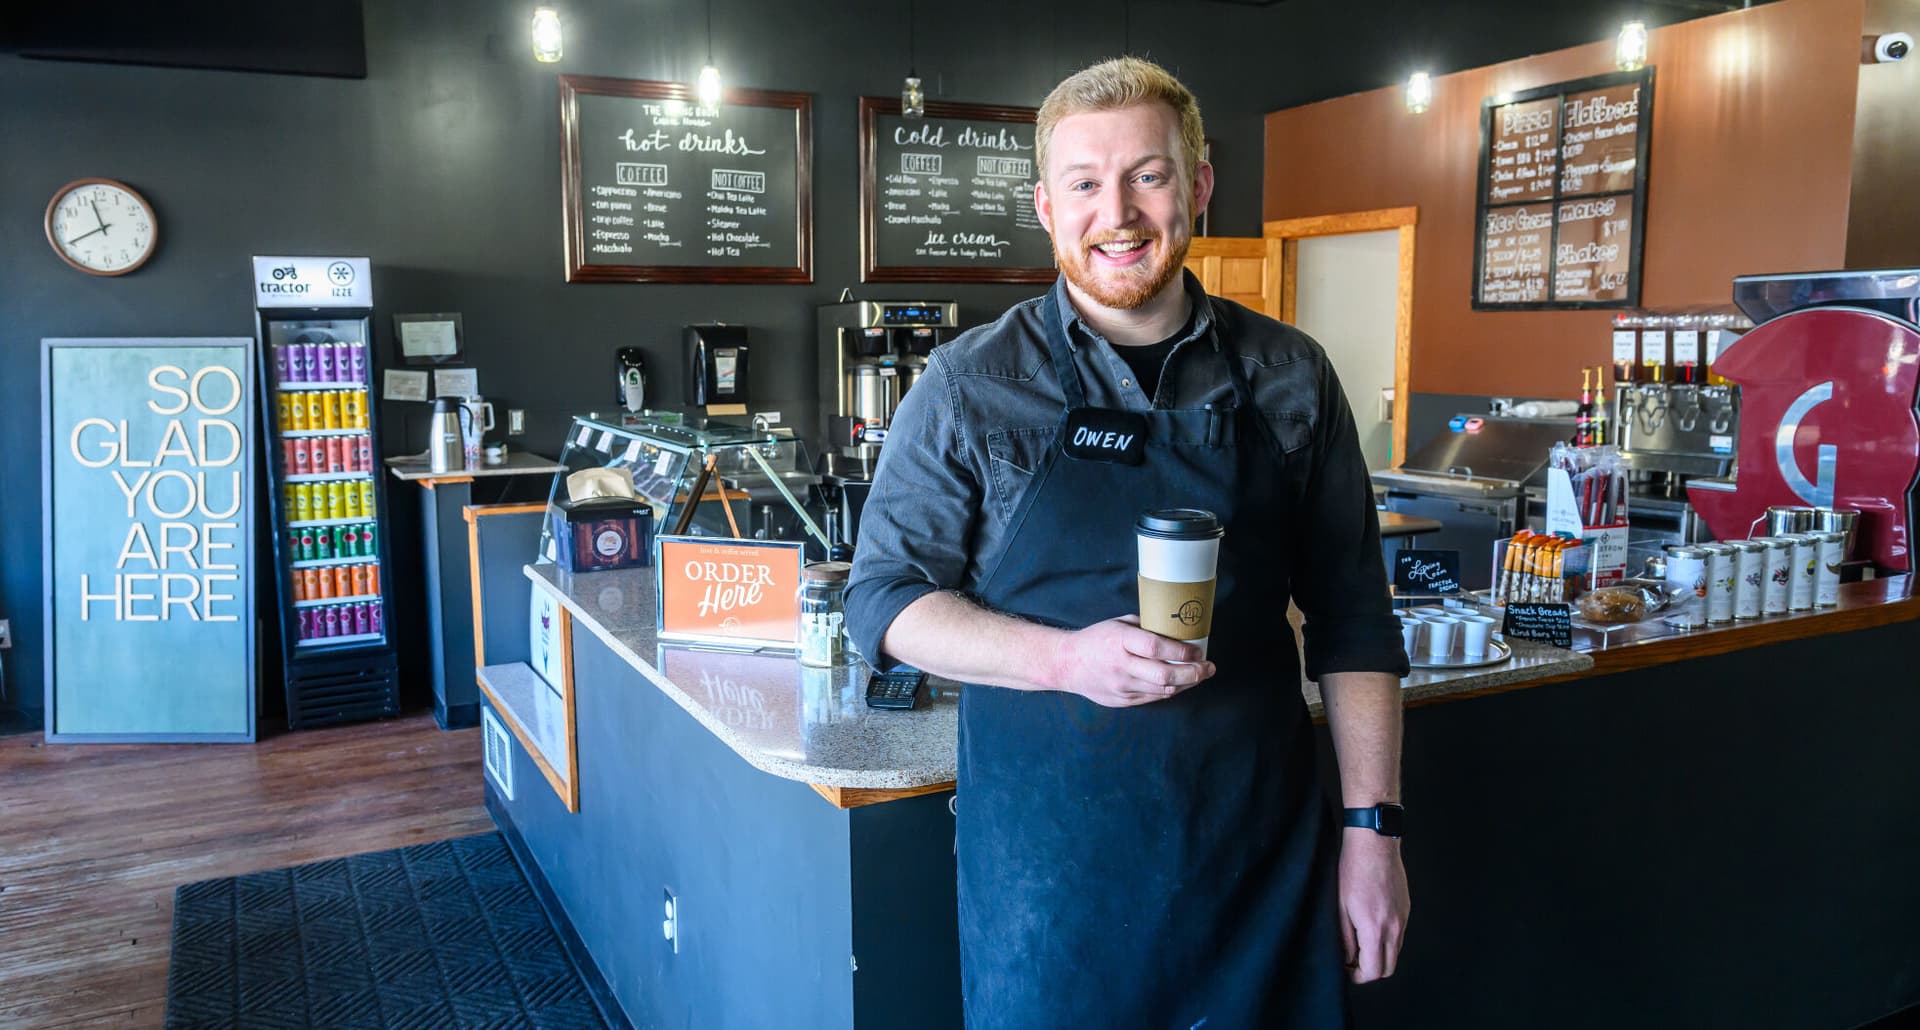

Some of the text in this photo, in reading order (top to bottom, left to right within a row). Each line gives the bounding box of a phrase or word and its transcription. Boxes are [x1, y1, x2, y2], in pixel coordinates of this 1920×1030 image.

[618, 128, 766, 156] hot drinks
[957, 126, 1033, 151] drinks
[619, 166, 664, 184] COFFEE
[904, 155, 938, 174] COFFEE
[714, 173, 732, 187] NOT
[952, 232, 1010, 246] cream
[1557, 241, 1618, 266] Shakes
[260, 281, 311, 294] tractor
[332, 287, 353, 297] IZZE
[147, 365, 242, 415] SO
[70, 418, 242, 468] GLAD
[1073, 426, 1134, 452] OWEN
[111, 470, 241, 520] YOU
[116, 522, 239, 570] ARE
[685, 560, 776, 587] ORDER
[80, 573, 239, 622] HERE
[697, 579, 763, 617] Here
[1508, 604, 1537, 616] Snack
